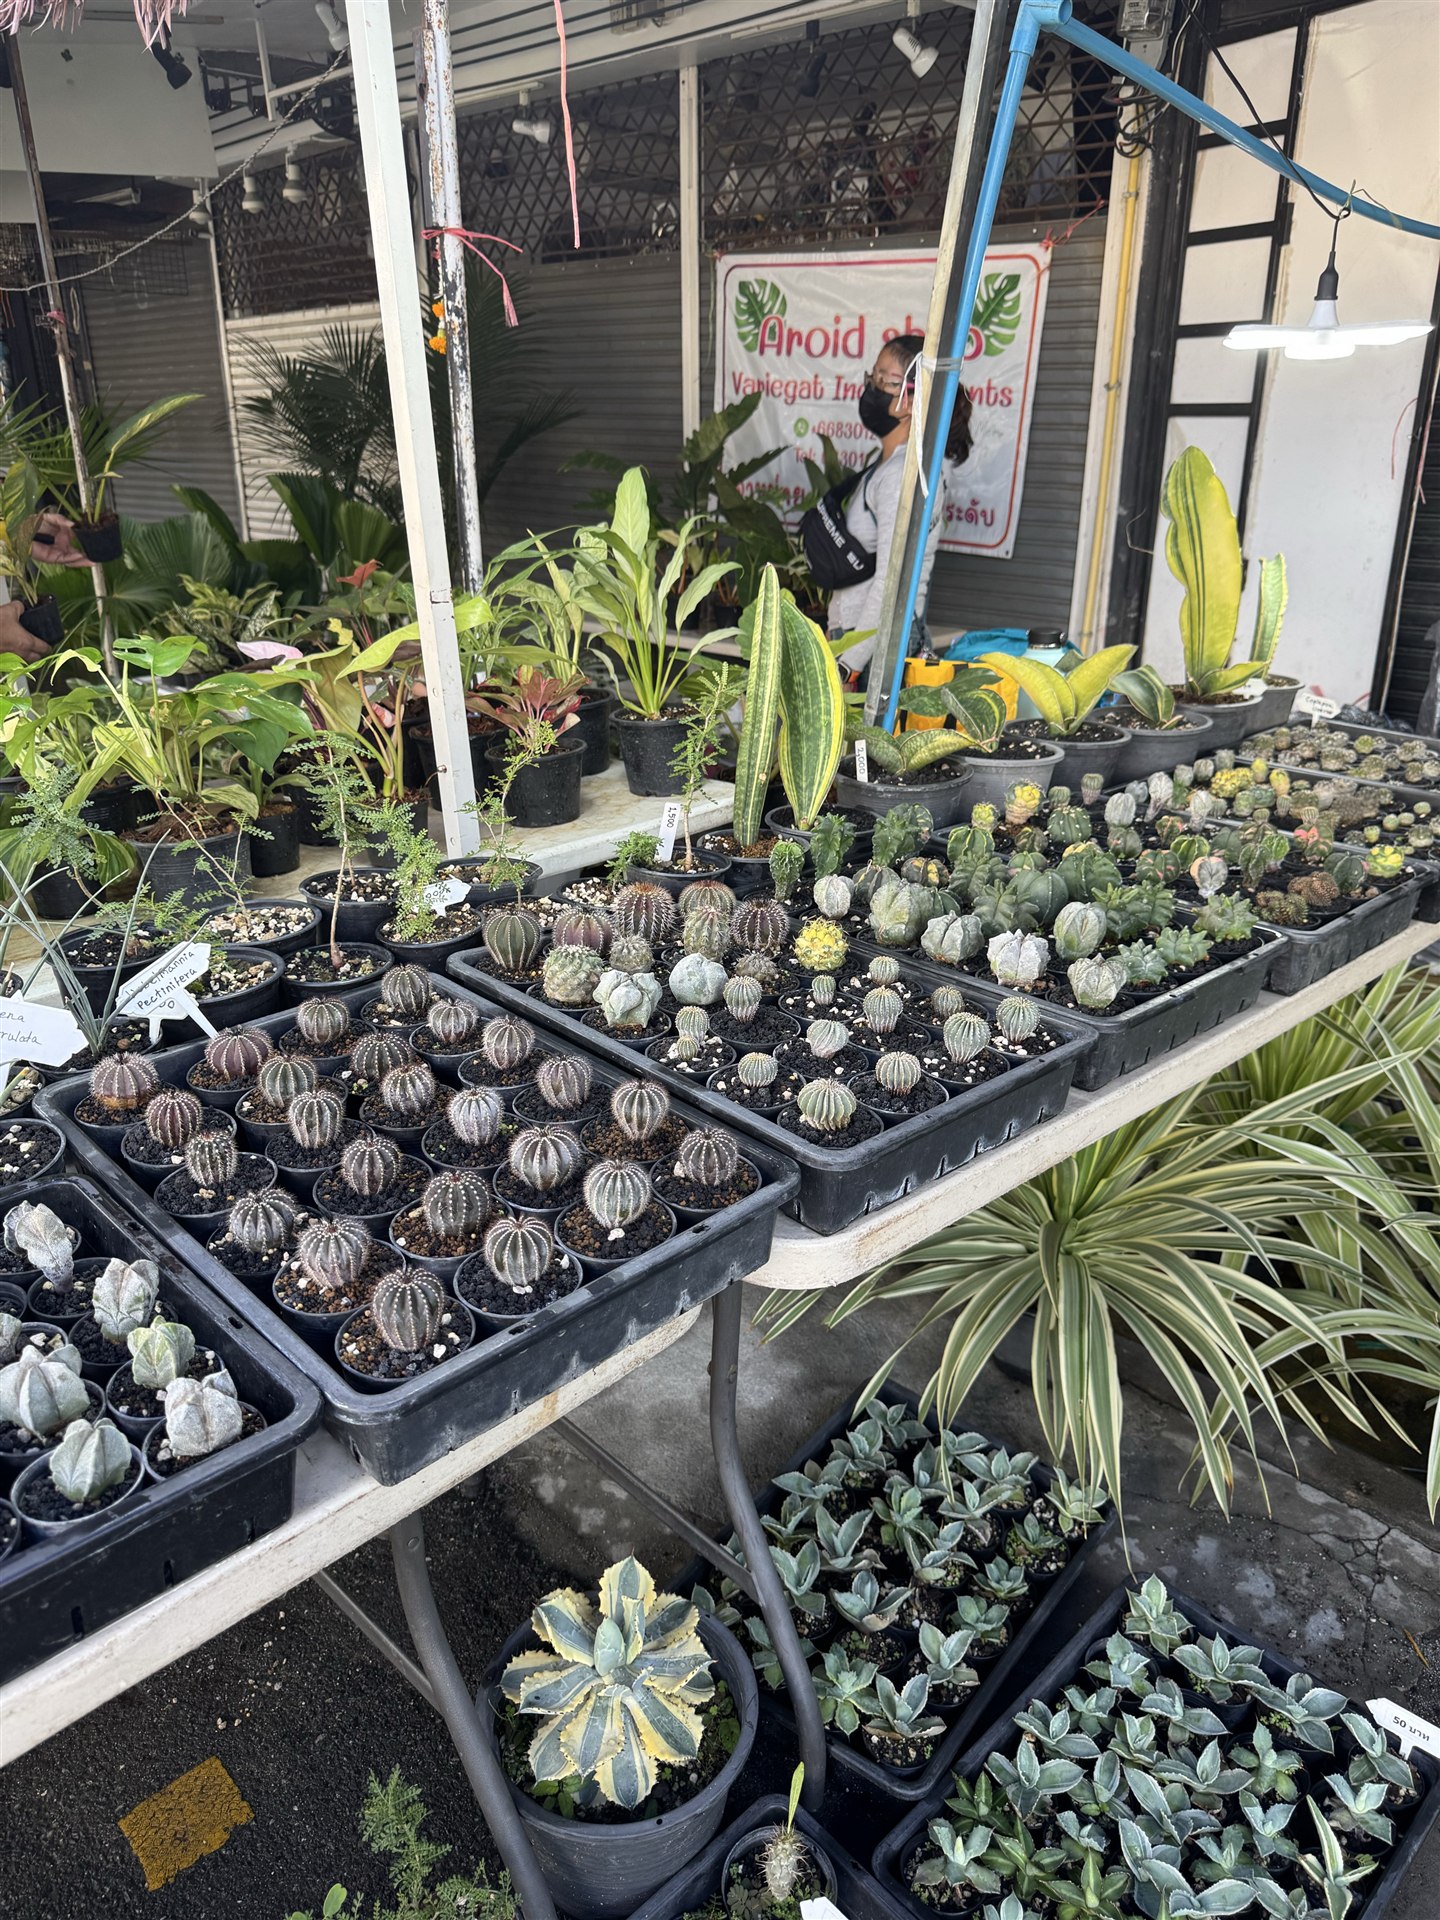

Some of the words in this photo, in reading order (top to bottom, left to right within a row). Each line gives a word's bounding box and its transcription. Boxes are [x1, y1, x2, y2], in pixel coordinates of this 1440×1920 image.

[758, 314, 865, 359] Aroid
[732, 371, 824, 406] Variegat
[943, 500, 995, 527] ระดับ
[666, 807, 677, 828] 1,500
[1393, 1716, 1407, 1728] 50
[1408, 1725, 1430, 1741] บาท
